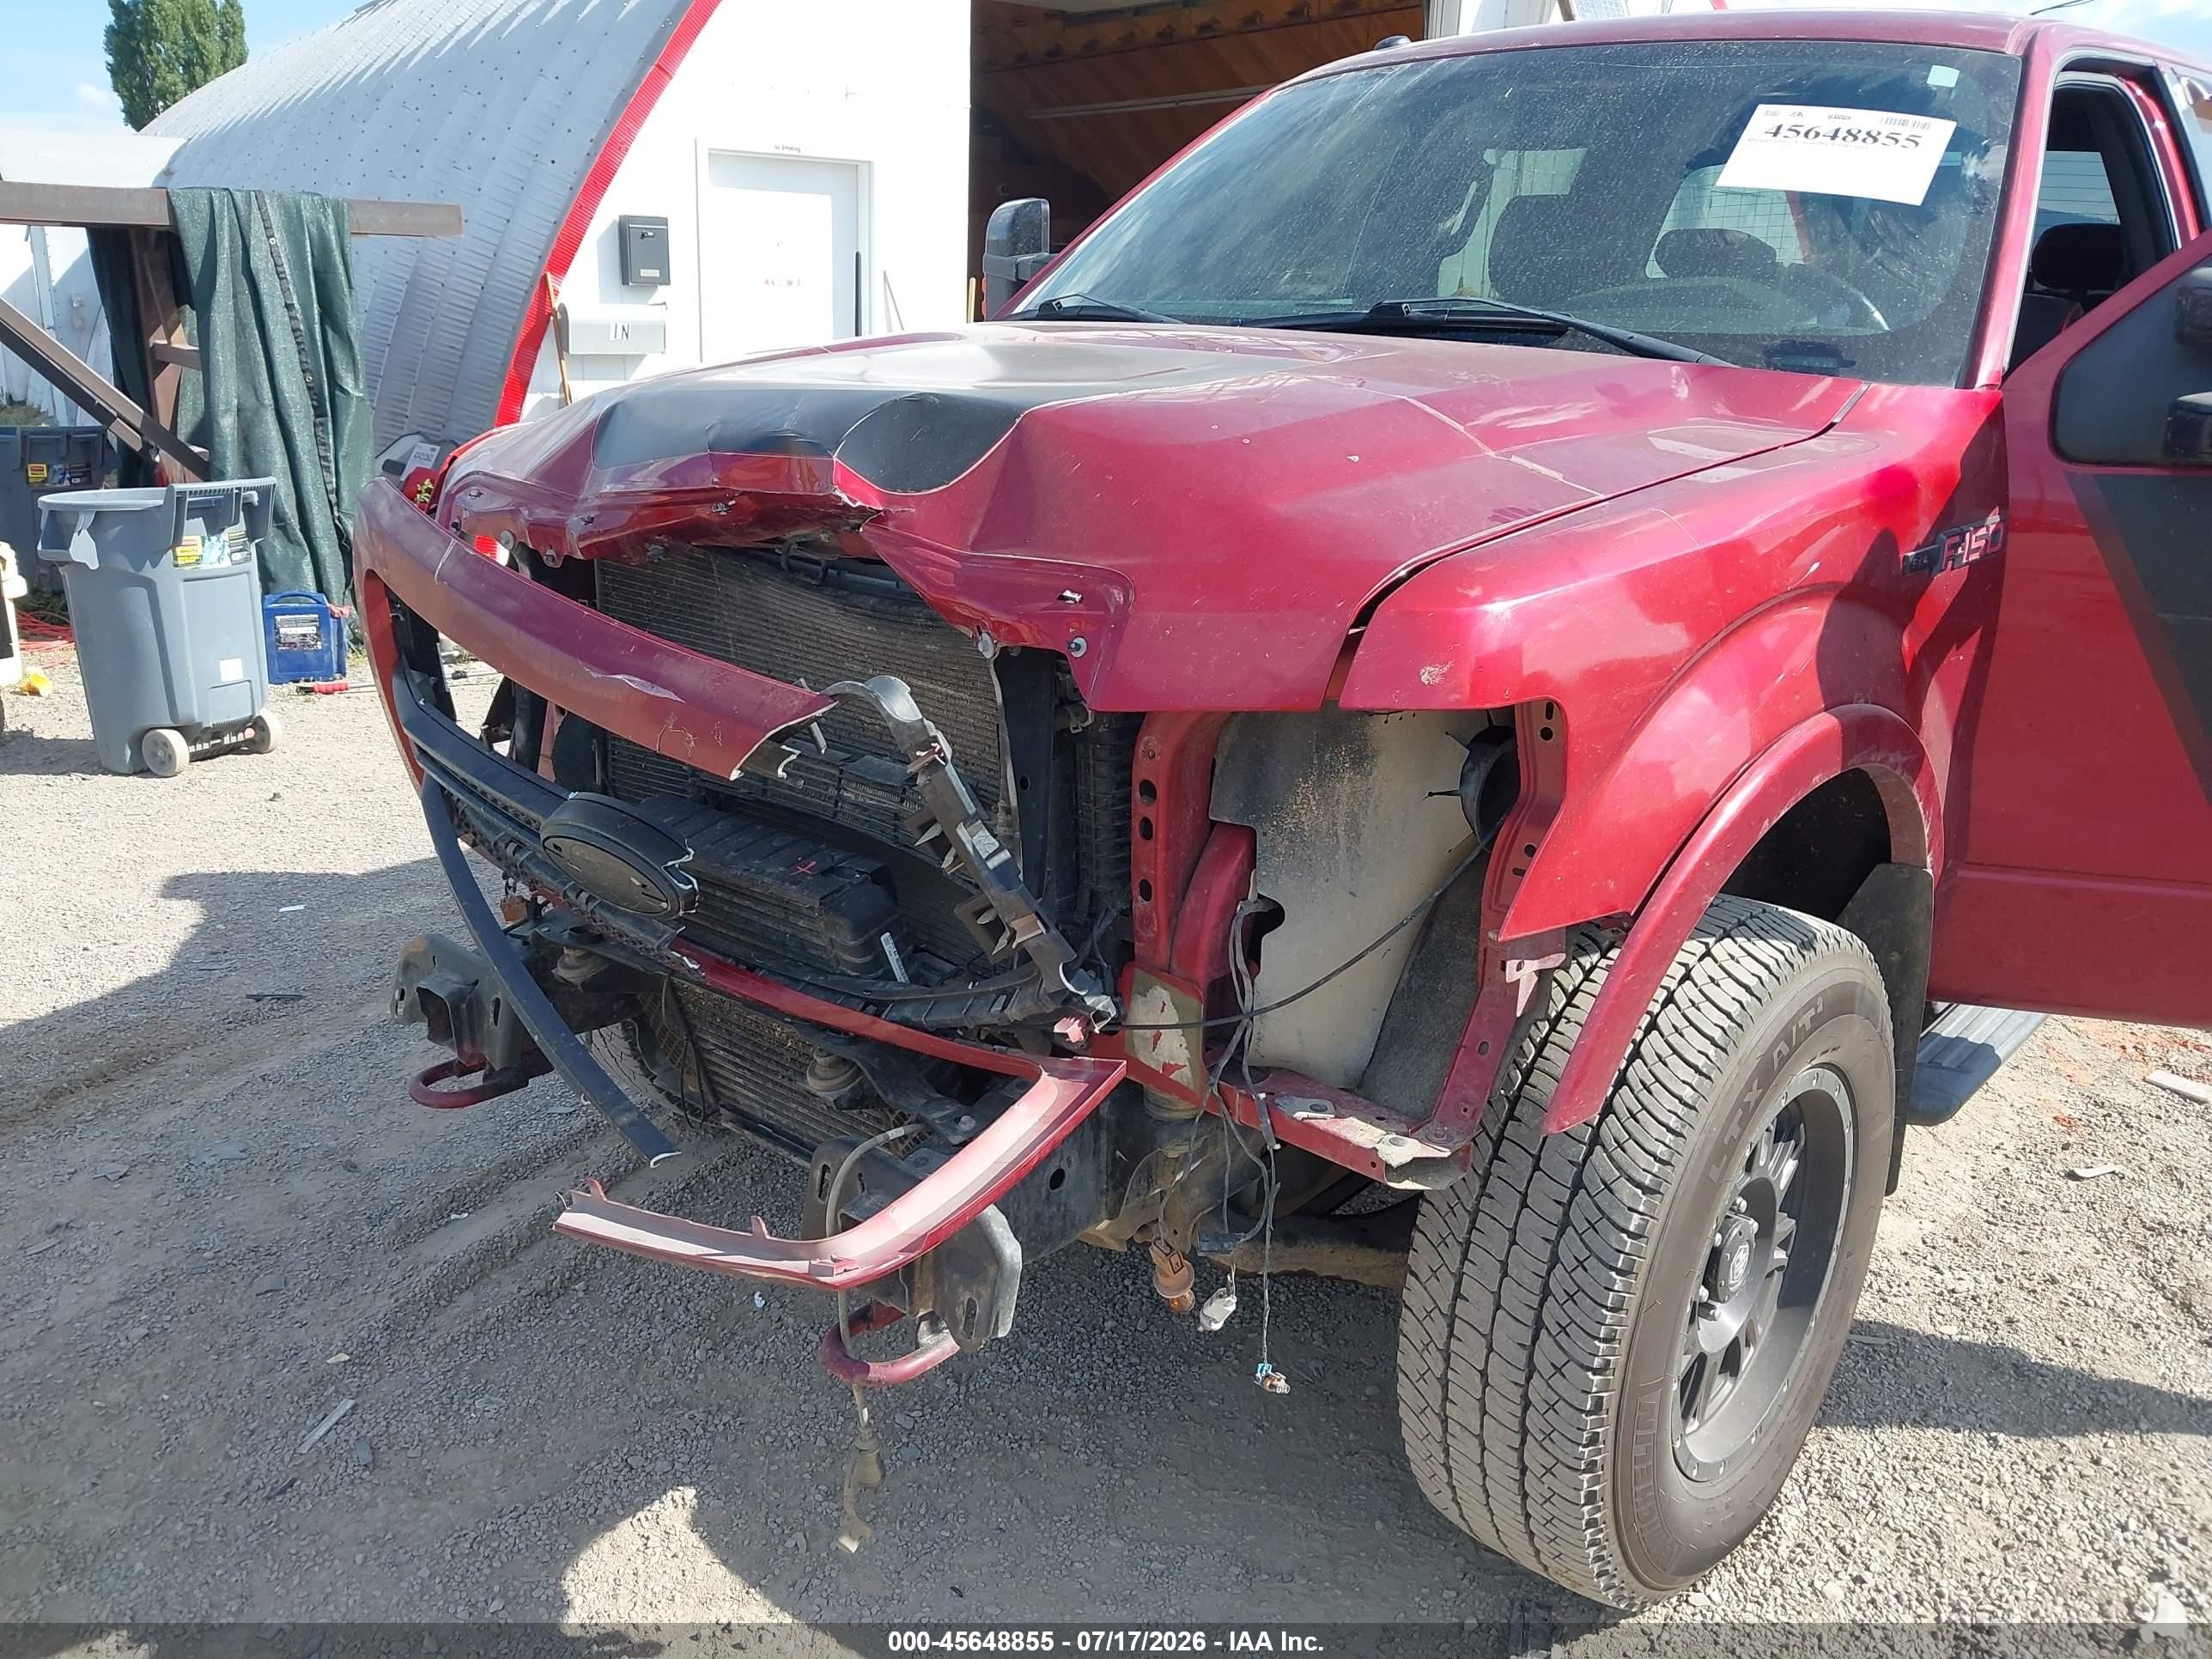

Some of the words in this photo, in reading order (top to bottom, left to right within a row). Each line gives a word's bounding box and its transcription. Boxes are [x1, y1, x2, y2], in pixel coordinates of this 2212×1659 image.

[1764, 124, 1923, 149] 45648855
[614, 322, 630, 340] IN
[1942, 520, 2005, 570] F-150
[1708, 1078, 1764, 1183] LTX
